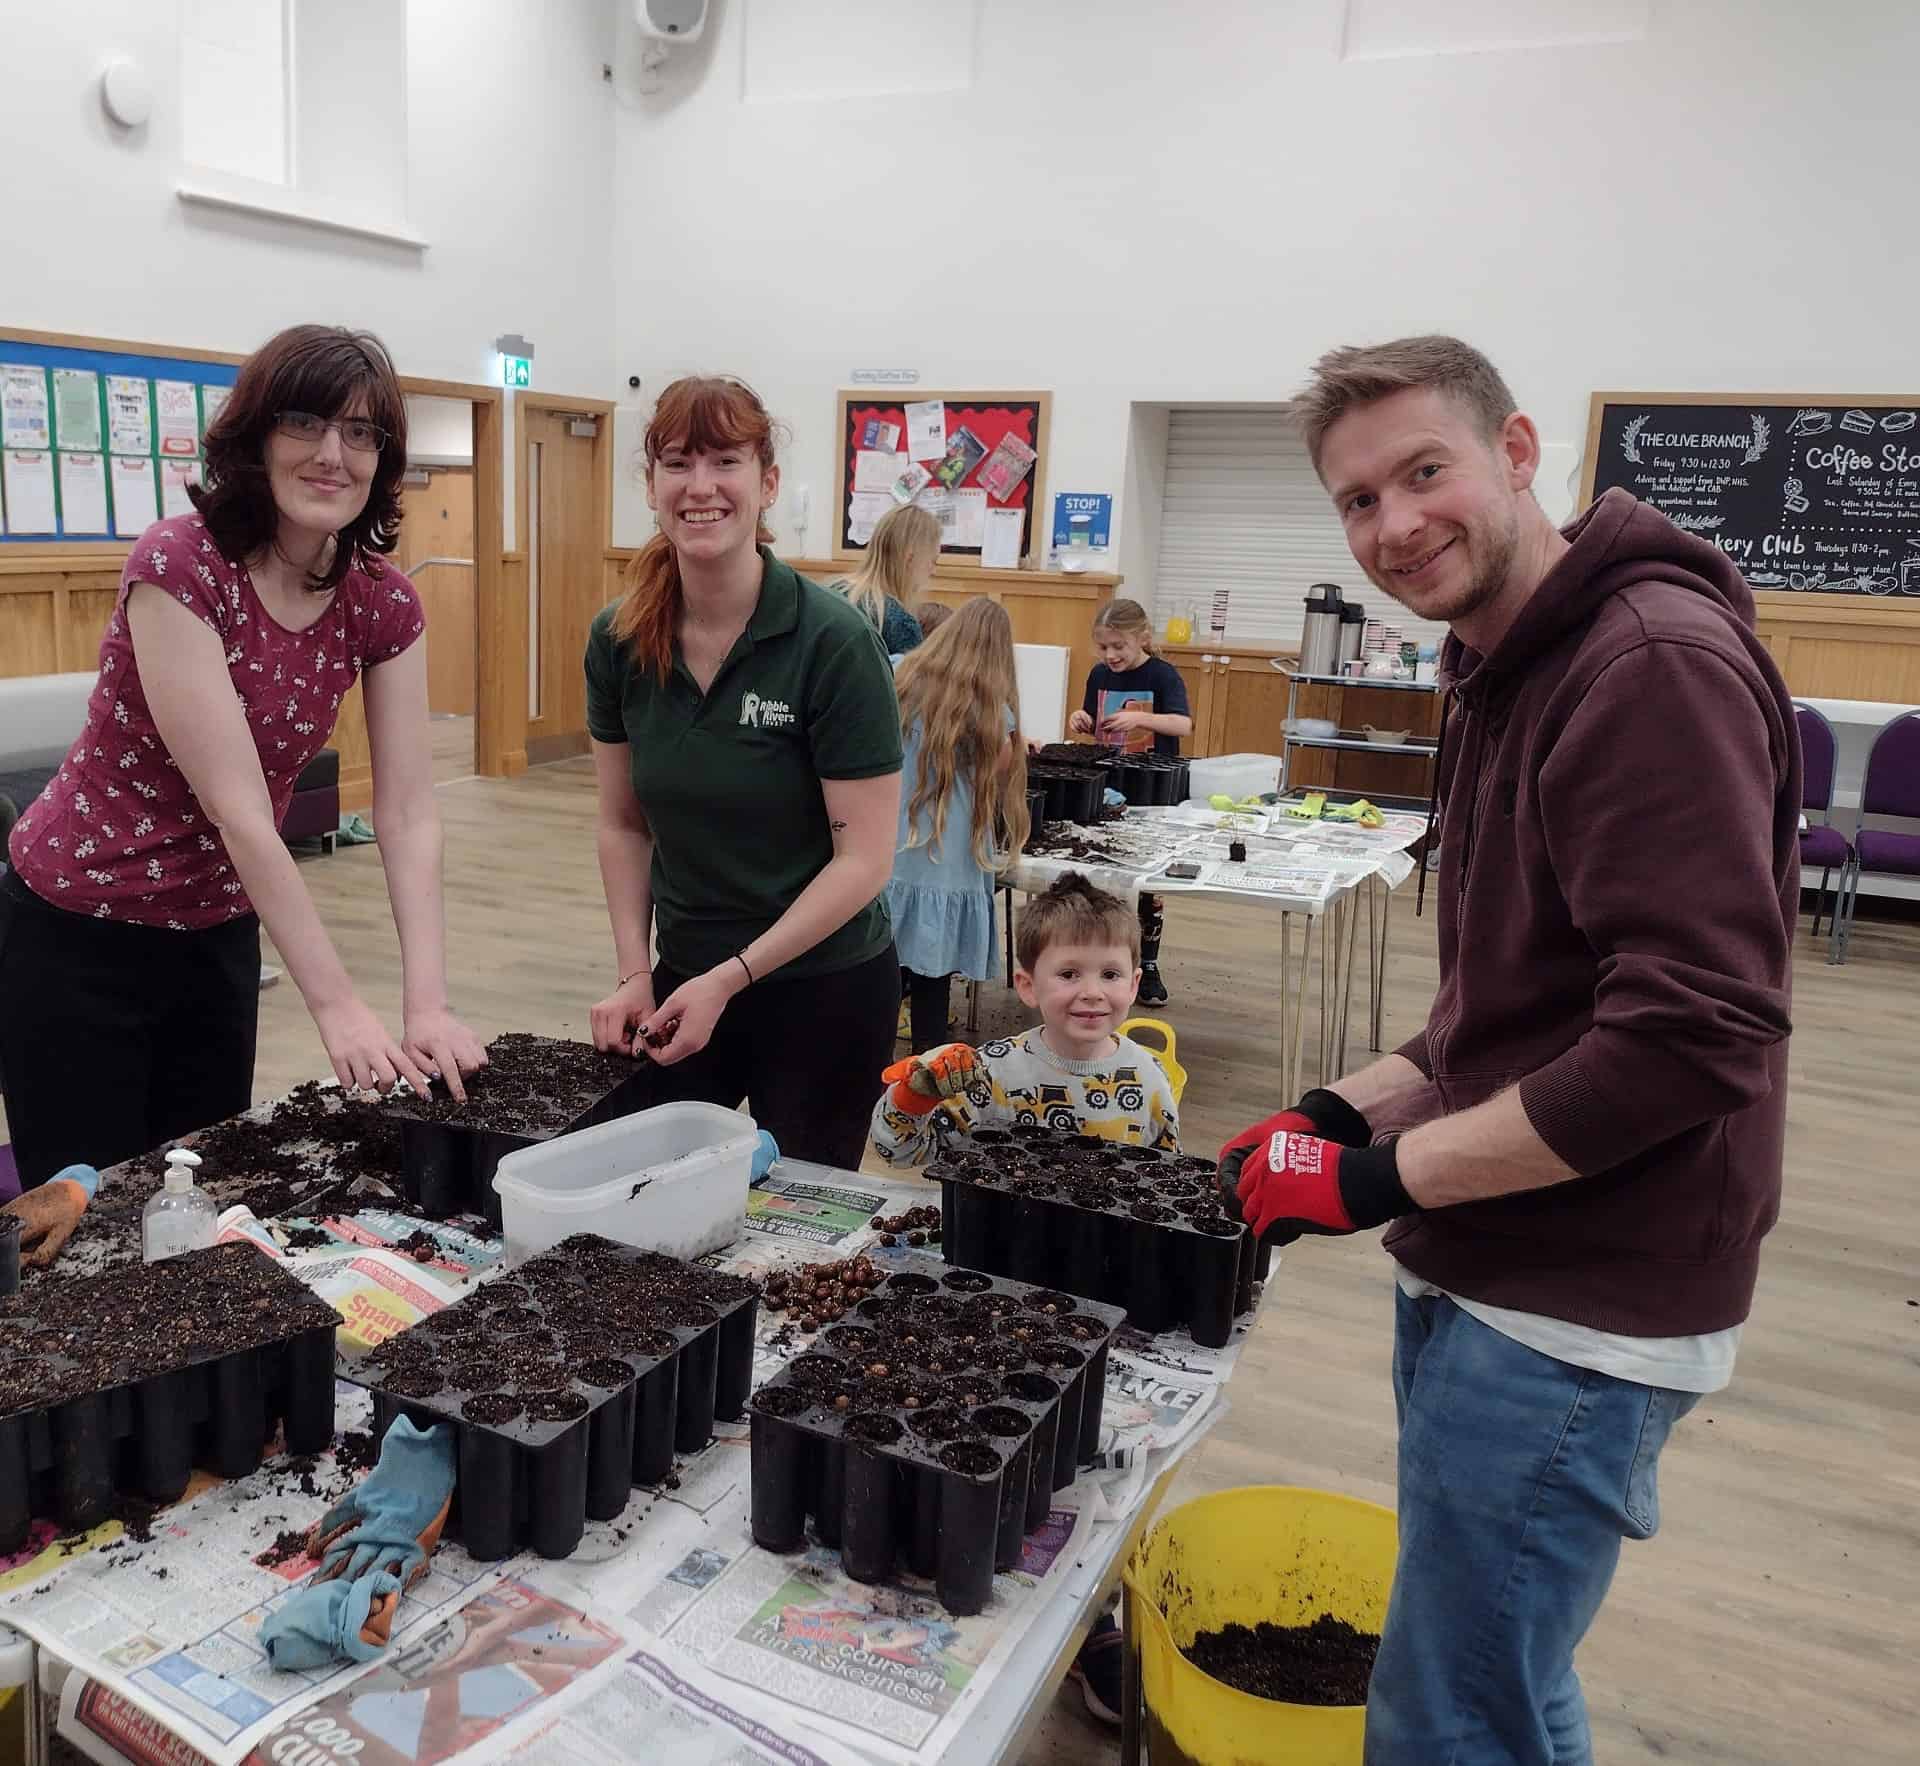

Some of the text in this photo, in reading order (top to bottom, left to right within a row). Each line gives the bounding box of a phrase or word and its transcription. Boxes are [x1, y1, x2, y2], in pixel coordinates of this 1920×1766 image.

[1640, 433, 1751, 448] THE OLIVE BRANCH
[1653, 457, 1675, 472] Friday
[1806, 444, 1873, 475] Coffee
[1826, 475, 1843, 486] Last
[1848, 476, 1880, 490] Saturday
[1886, 478, 1895, 488] of
[1065, 497, 1100, 510] STOP!
[1714, 533, 1805, 557] kery Club
[775, 1225, 832, 1243] DRIVEWAY
[820, 1652, 936, 1705] Skegness
